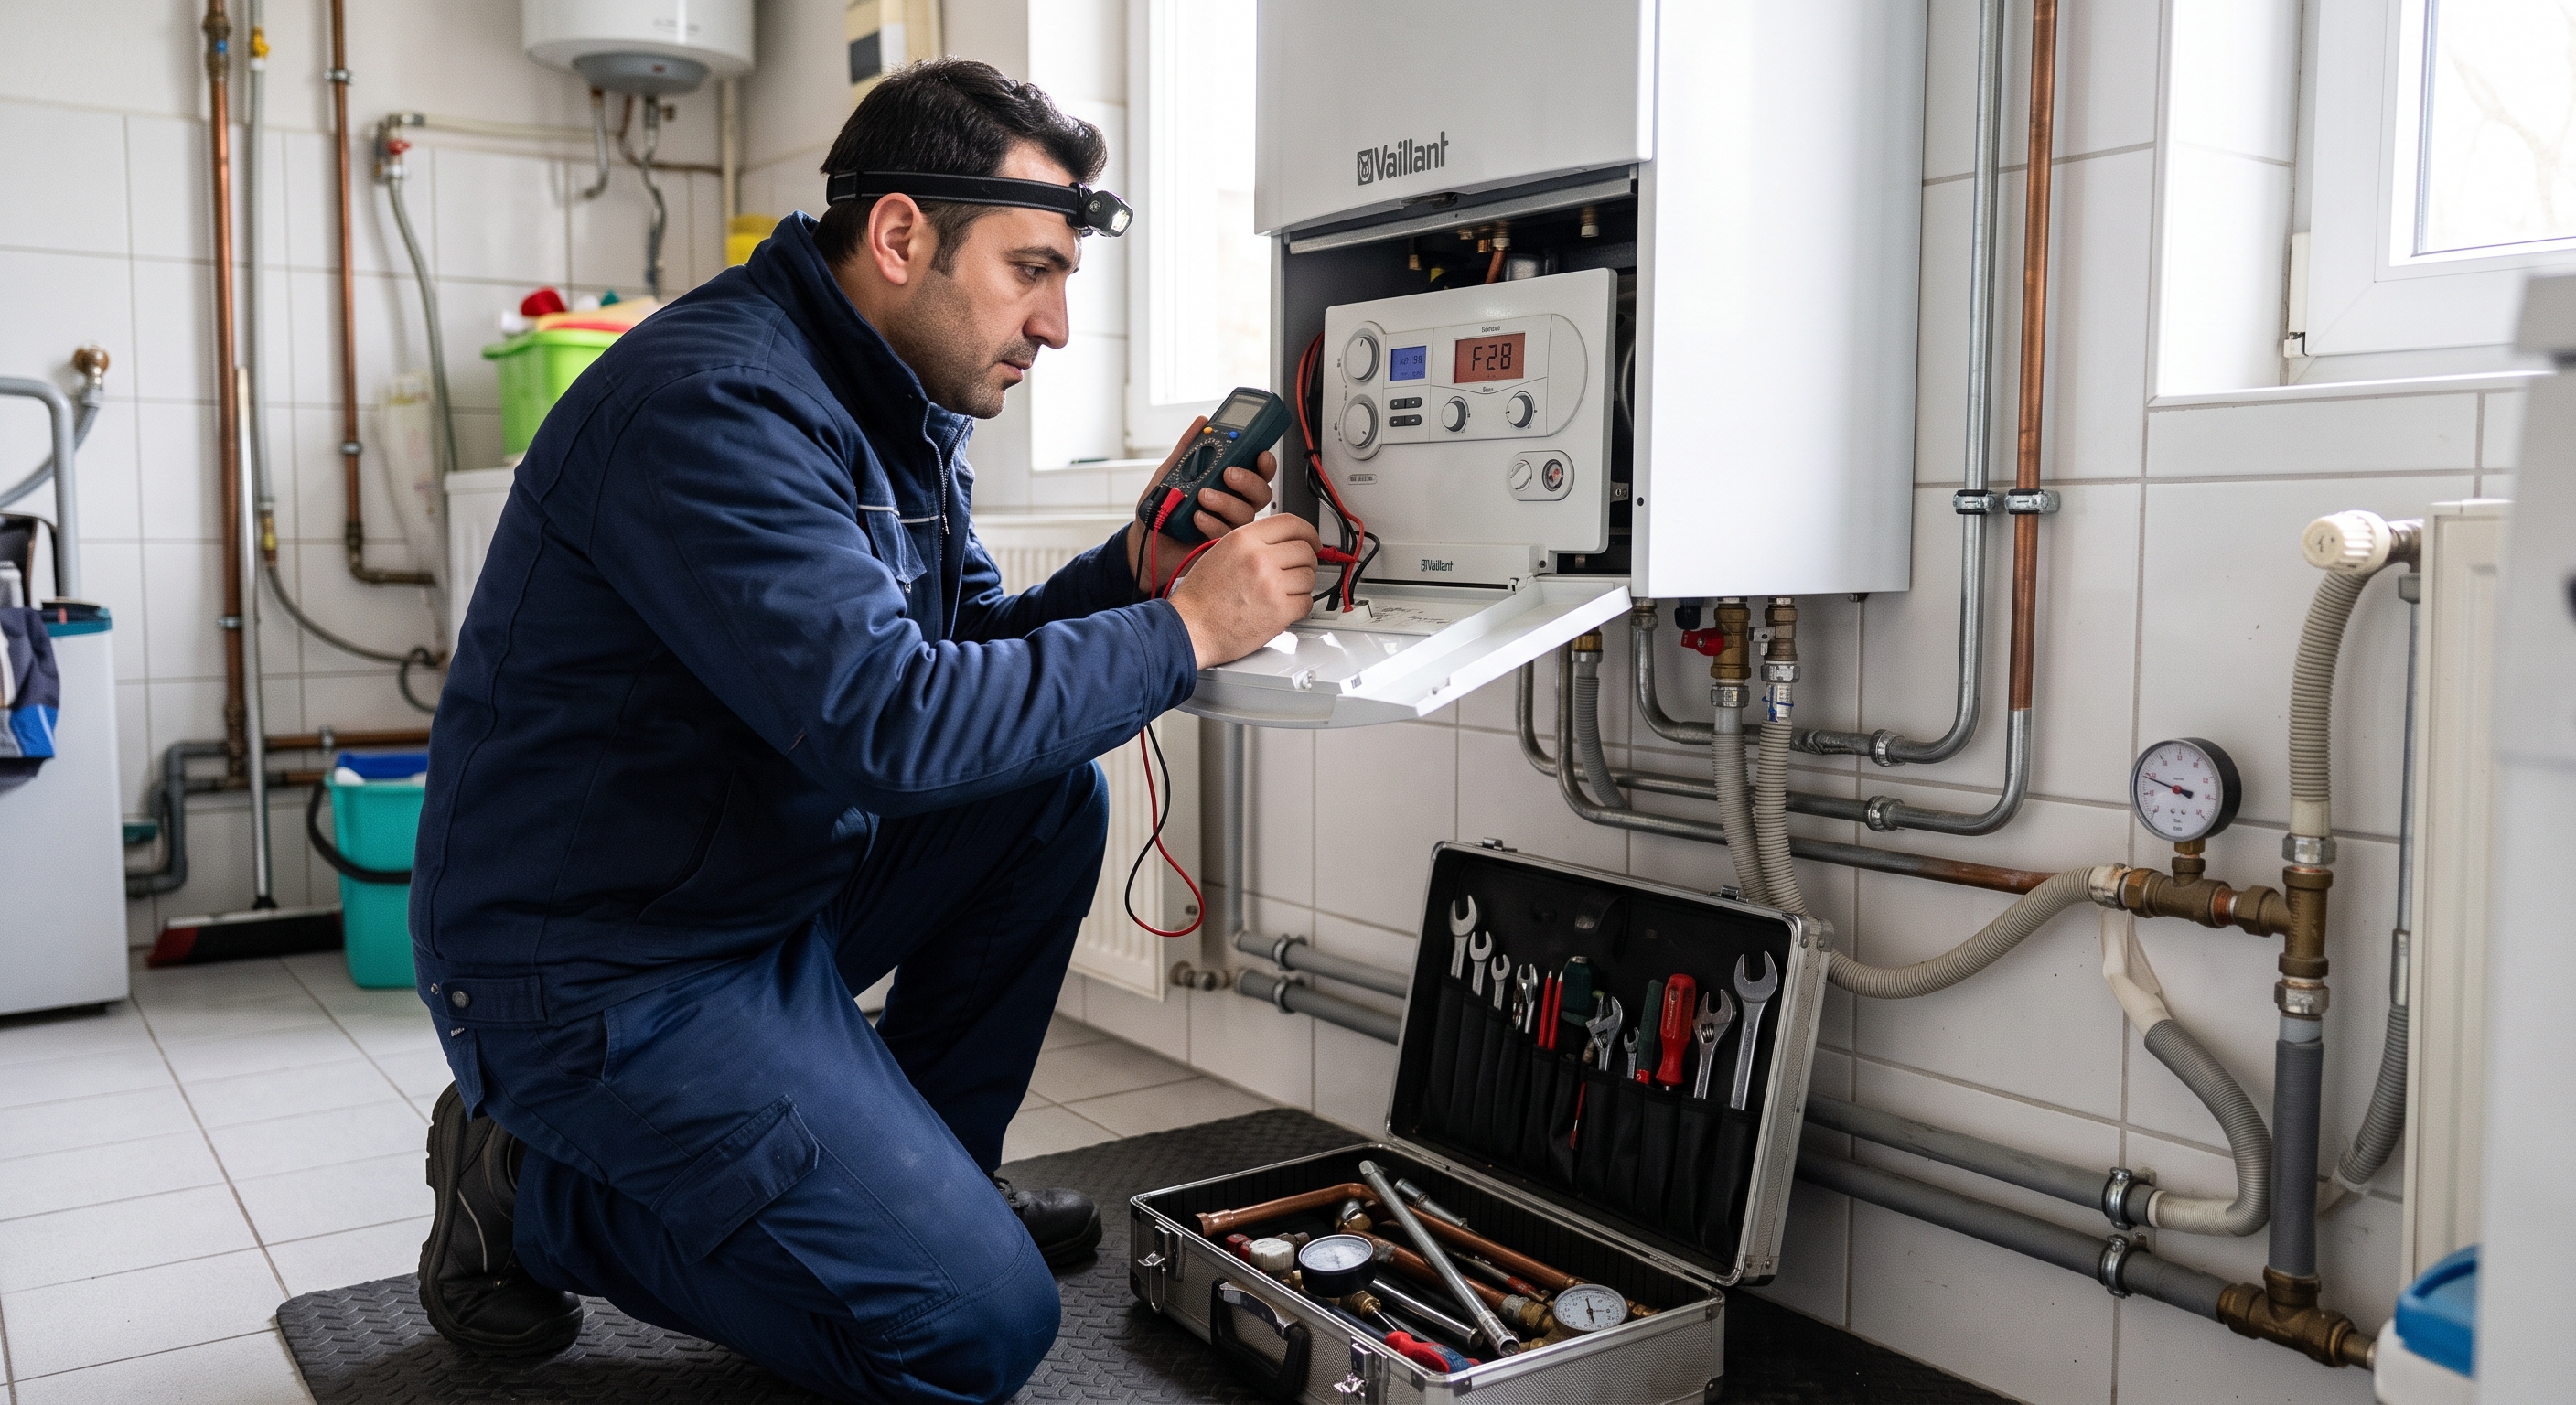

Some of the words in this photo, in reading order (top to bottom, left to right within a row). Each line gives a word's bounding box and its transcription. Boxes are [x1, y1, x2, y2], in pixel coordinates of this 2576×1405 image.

[1374, 131, 1449, 181] Vaillant
[1472, 342, 1512, 372] F28
[1427, 559, 1454, 572] Vaillant
